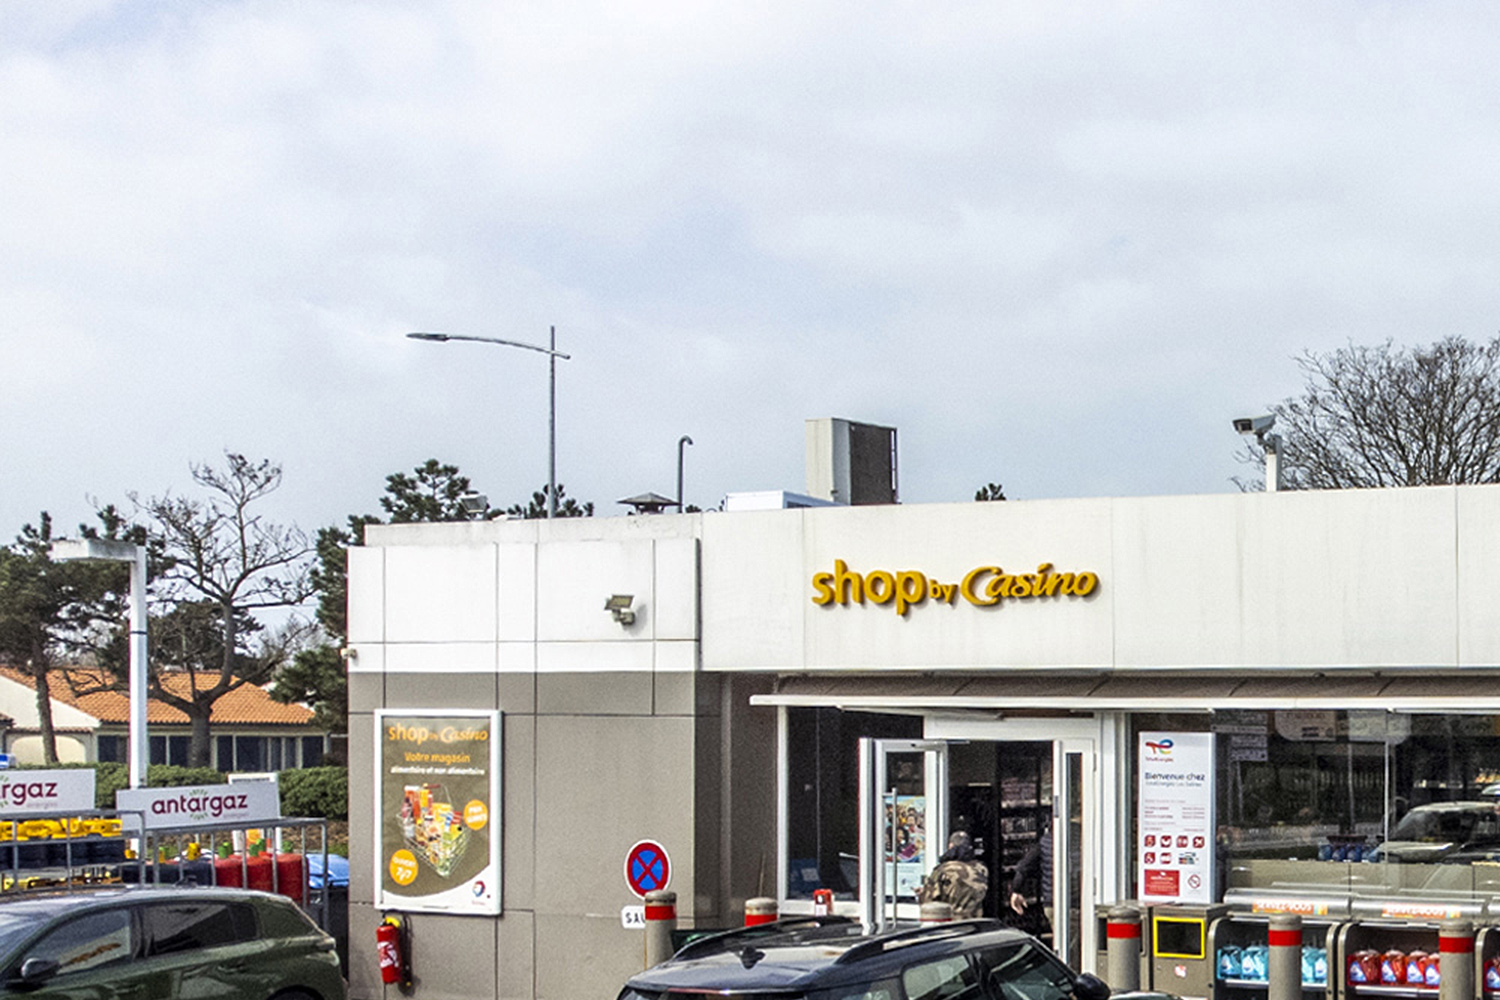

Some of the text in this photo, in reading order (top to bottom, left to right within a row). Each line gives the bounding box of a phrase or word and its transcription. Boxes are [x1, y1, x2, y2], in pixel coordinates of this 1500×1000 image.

[812, 559, 1103, 615] shop by Casino
[388, 722, 429, 745] shop
[440, 726, 488, 743] Casino
[404, 752, 471, 765] Votre magasin
[1144, 772, 1205, 781] Bienvenue chez
[0, 781, 58, 806] rgaz
[152, 794, 248, 817] antargaz
